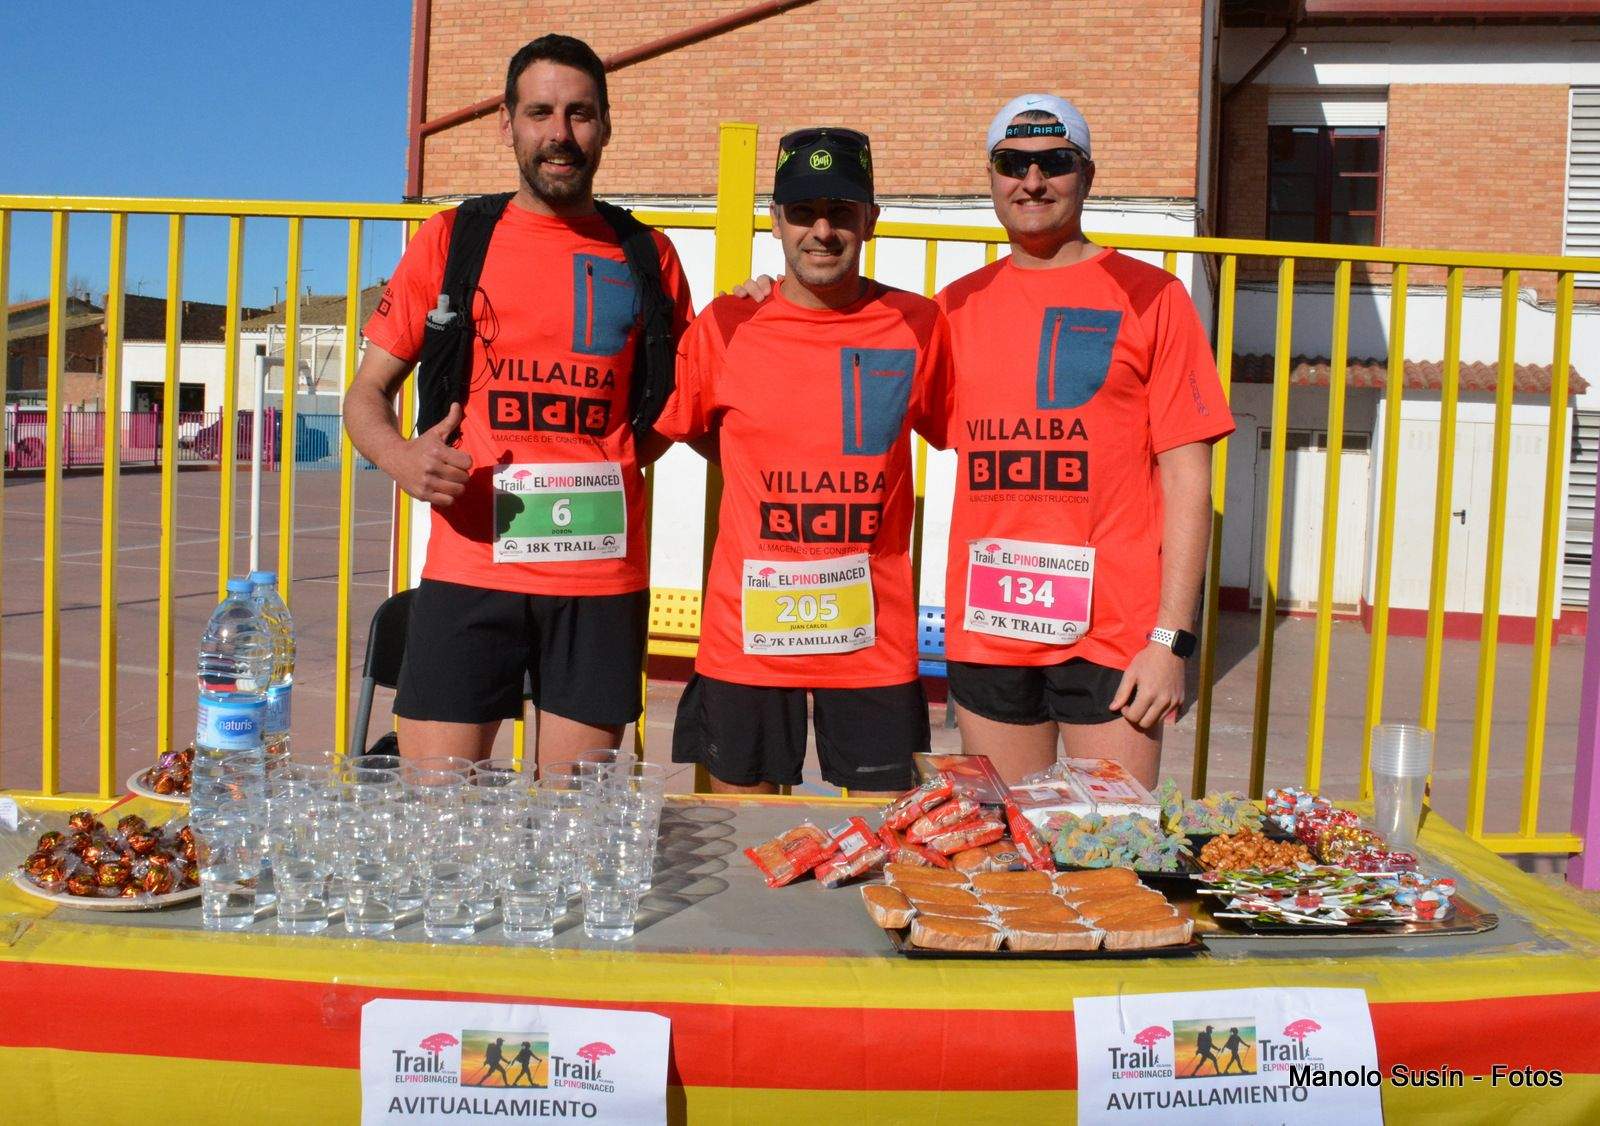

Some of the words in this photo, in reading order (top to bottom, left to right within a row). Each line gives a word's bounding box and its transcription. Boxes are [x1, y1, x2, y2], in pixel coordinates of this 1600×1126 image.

[488, 358, 616, 391] VILLALBA
[966, 418, 1089, 441] VILLALBA
[499, 479, 523, 491] Trail
[534, 474, 620, 488] ELPINOBINACED
[760, 470, 887, 493] VILLALBA
[551, 498, 572, 527] 6
[526, 542, 550, 553] 18K
[554, 541, 596, 552] TRAIL
[810, 547, 822, 555] DE
[974, 550, 994, 564] Trail
[1002, 552, 1090, 572] ELPINOBINACED
[747, 575, 769, 588] Trail
[779, 567, 866, 586] ELPINOBINACED
[998, 575, 1055, 608] 134
[775, 594, 840, 623] 205
[990, 615, 1007, 629] 7K
[1011, 618, 1056, 636] TRAIL
[770, 637, 786, 647] 7K
[789, 635, 849, 646] FAMILIAR
[219, 719, 253, 731] naturis
[1108, 1046, 1154, 1069] Trail
[1258, 1038, 1305, 1061] Trail
[392, 1049, 439, 1073] Trail
[551, 1055, 596, 1081] Trail
[395, 1074, 458, 1084] ELPINOBINACED
[1112, 1069, 1173, 1080] ELPINOBINACED
[554, 1079, 615, 1093] ELPINOBINACED
[388, 1096, 598, 1118] AVITUALLAMIENTO
[1106, 1085, 1308, 1110] AVITUALLAMIENTO
